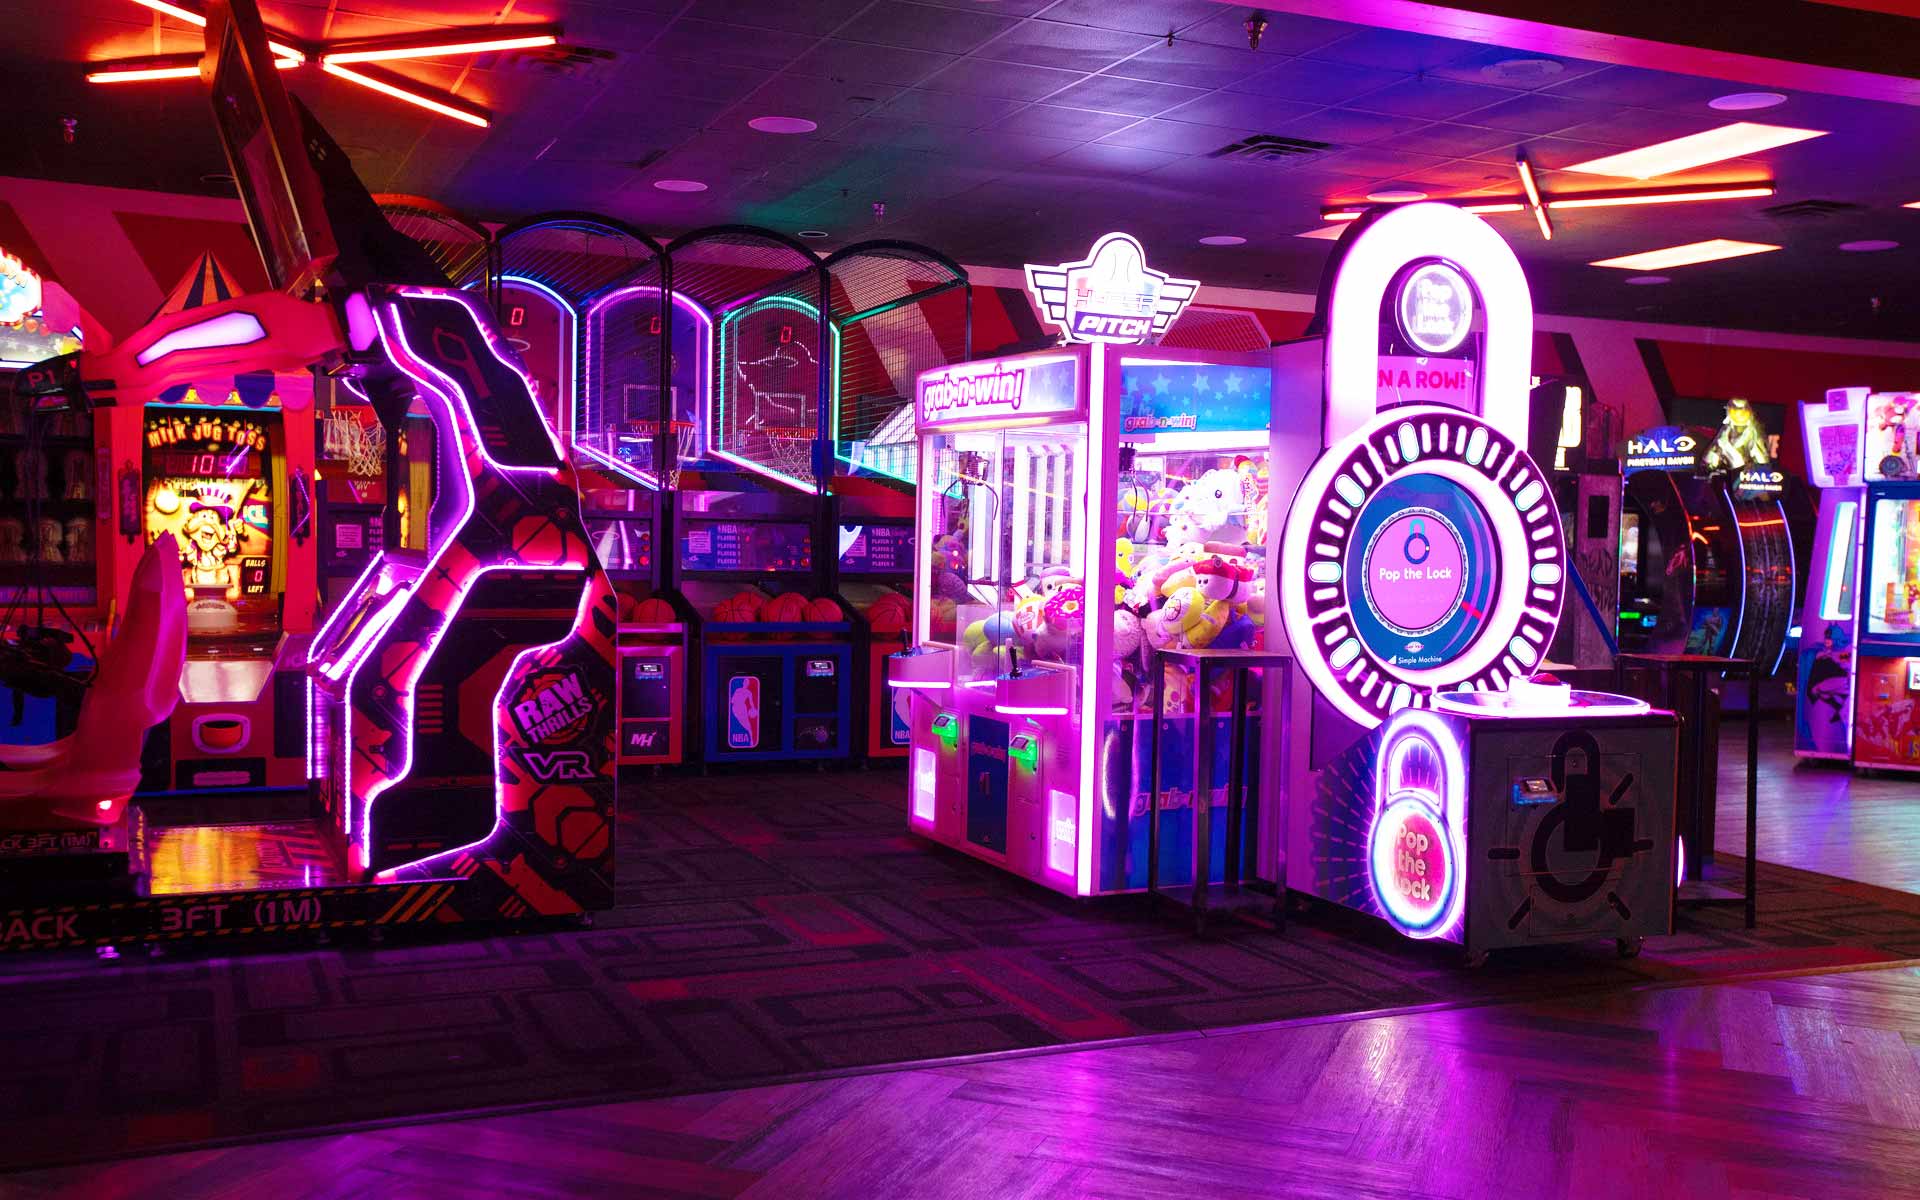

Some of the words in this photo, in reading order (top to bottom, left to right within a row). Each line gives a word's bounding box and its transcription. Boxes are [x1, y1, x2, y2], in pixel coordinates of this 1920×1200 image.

[1077, 314, 1153, 337] PITCH
[27, 369, 56, 388] P1
[1397, 370, 1411, 389] A
[1415, 370, 1466, 390] ROW!
[146, 422, 187, 448] MILK
[191, 422, 222, 441] JUG
[227, 425, 266, 451] TOSS
[1627, 436, 1697, 455] HALO
[1739, 471, 1784, 483] HALO
[875, 527, 891, 537] NBA
[245, 559, 267, 568] BALLS
[254, 570, 264, 582] 0
[1379, 567, 1401, 584] Pop
[1403, 567, 1423, 580] the
[1426, 566, 1453, 580] Lock
[247, 585, 264, 594] LEFT
[1398, 656, 1417, 665] Simple
[1418, 655, 1443, 664] Machine
[514, 672, 583, 731] RAW
[526, 697, 593, 743] THRILLS
[731, 733, 750, 744] NBA
[523, 751, 597, 780] VR
[1397, 823, 1429, 858] Pop
[1397, 849, 1426, 877] the
[160, 904, 229, 931] 3FT
[254, 898, 322, 926] (1M)
